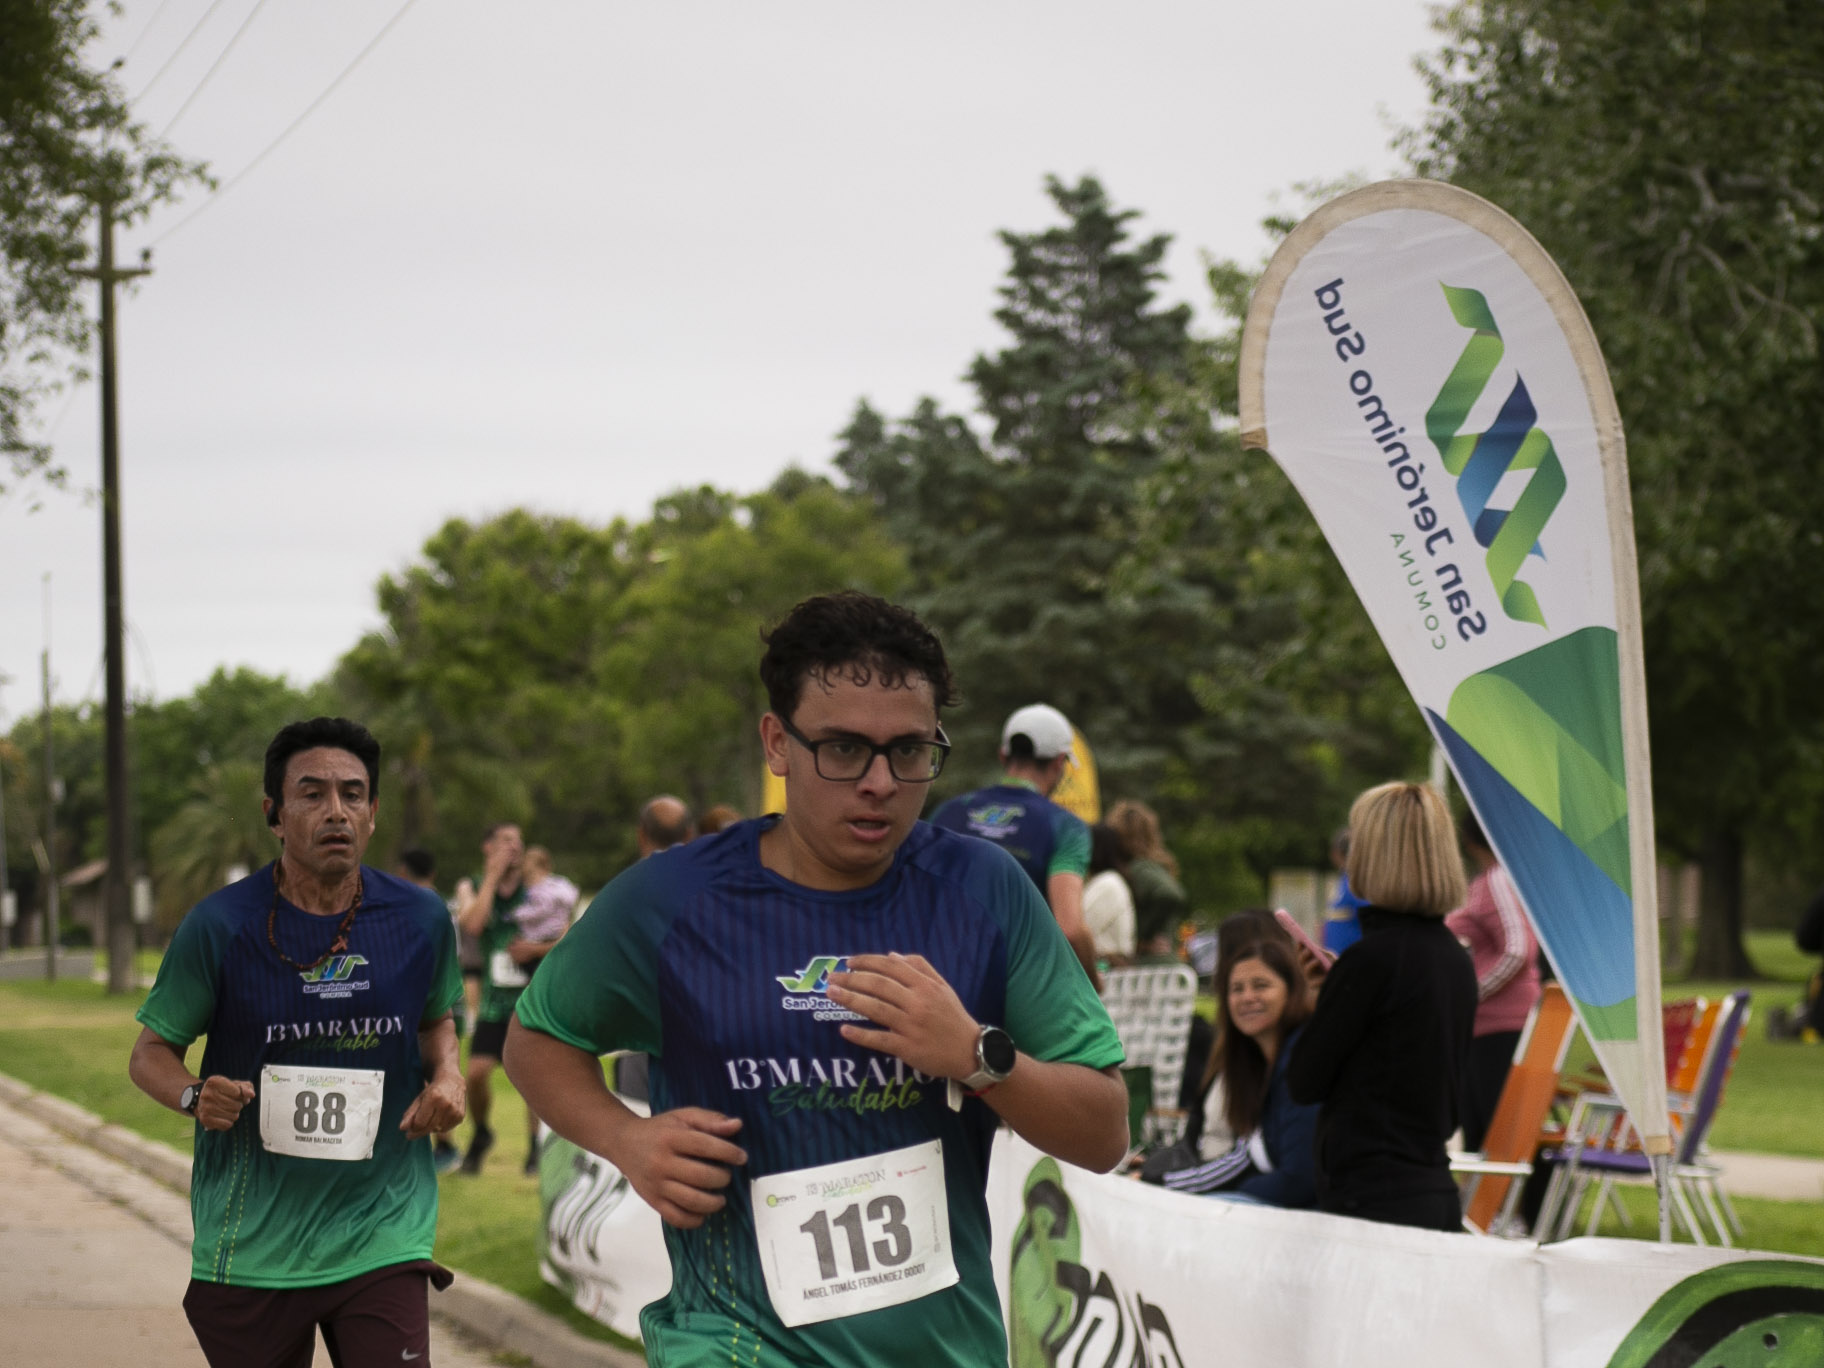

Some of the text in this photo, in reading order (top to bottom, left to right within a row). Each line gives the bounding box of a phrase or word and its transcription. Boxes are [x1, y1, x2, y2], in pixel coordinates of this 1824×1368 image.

[784, 997, 808, 1009] San
[292, 1015, 404, 1040] MARATON
[767, 1057, 946, 1089] MARATO
[293, 1090, 347, 1135] 88
[768, 1077, 922, 1117] Saludable
[799, 1194, 913, 1280] 113
